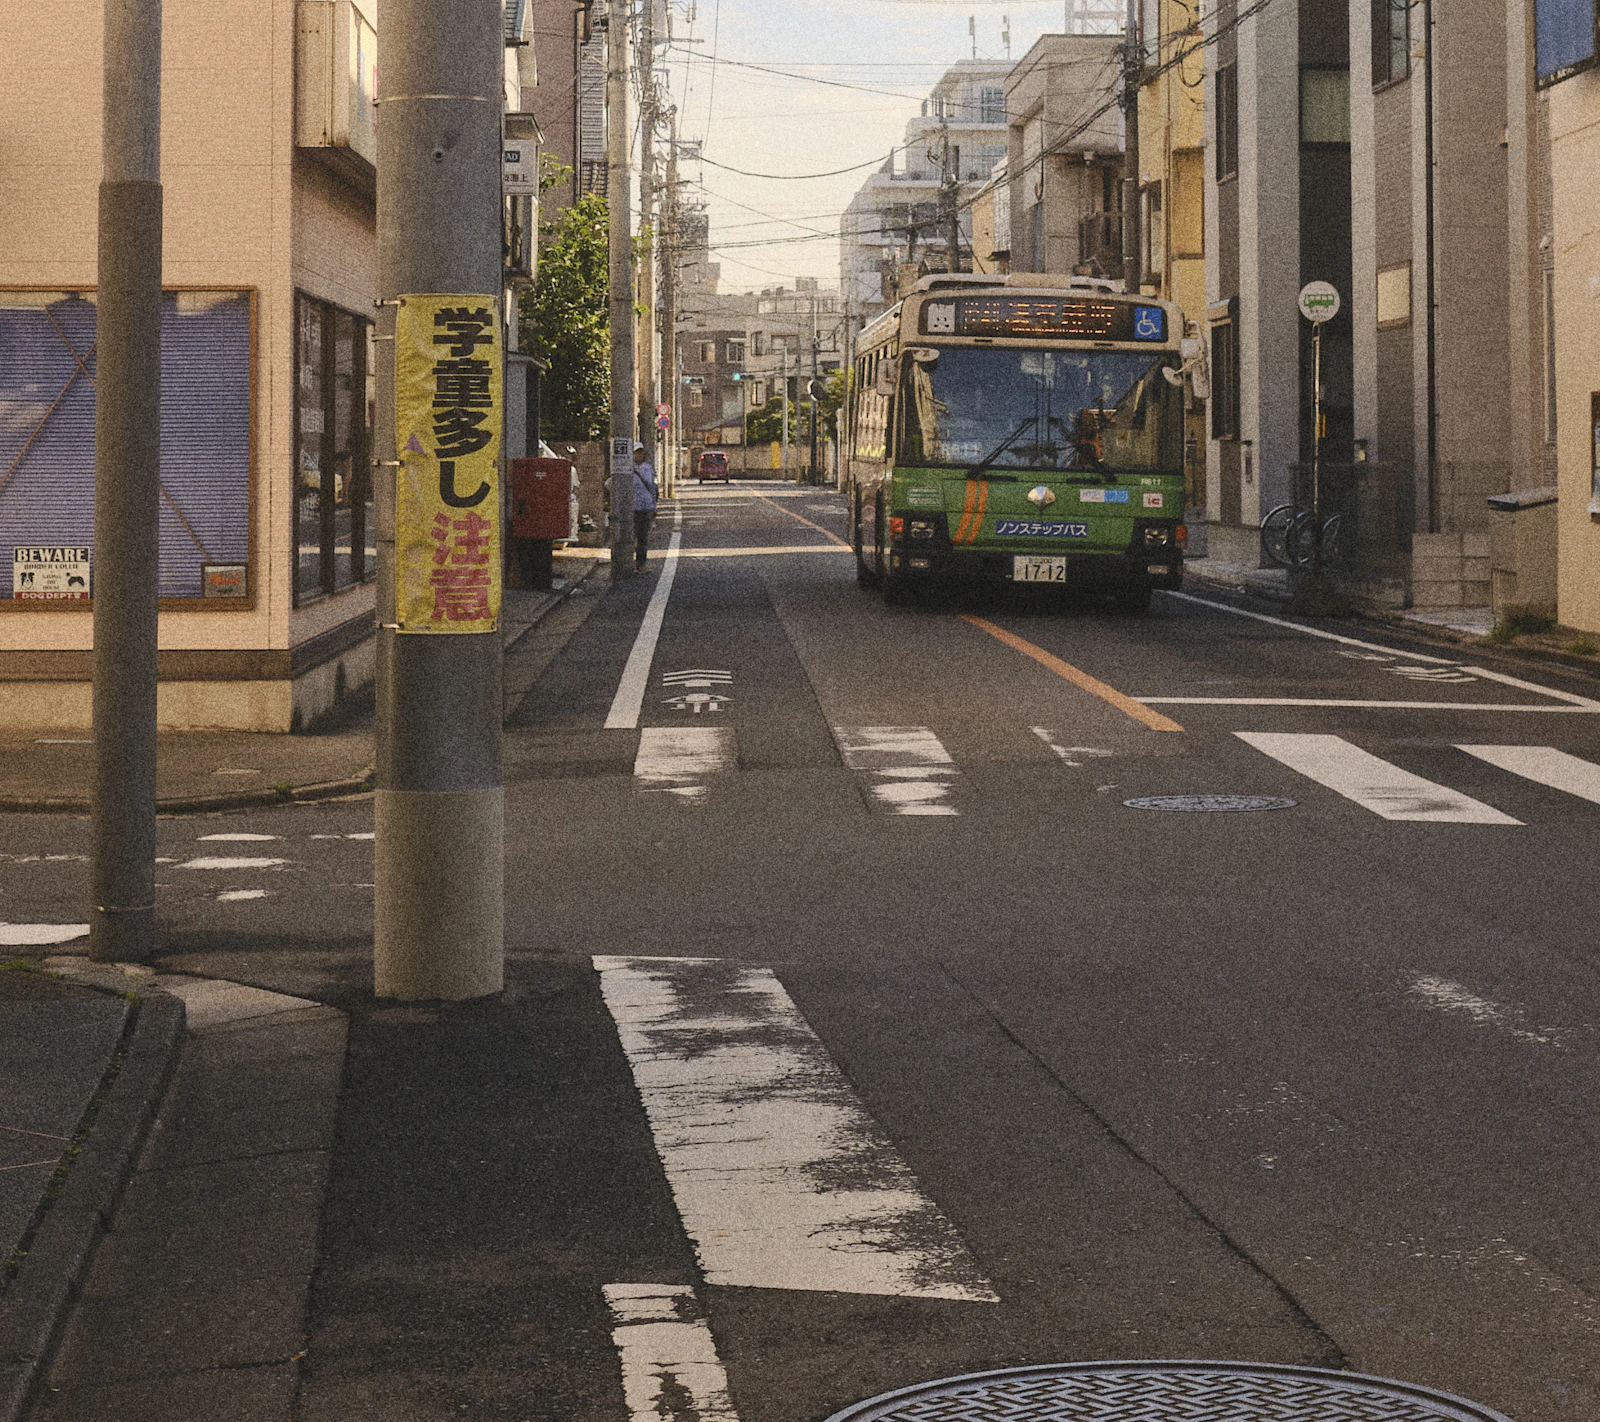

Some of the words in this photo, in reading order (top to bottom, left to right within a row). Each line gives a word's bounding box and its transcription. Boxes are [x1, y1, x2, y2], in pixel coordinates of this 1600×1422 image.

[430, 307, 493, 622] 学童多し注意
[997, 522, 1087, 536] ノンステップバス
[17, 548, 86, 562] BEWARE
